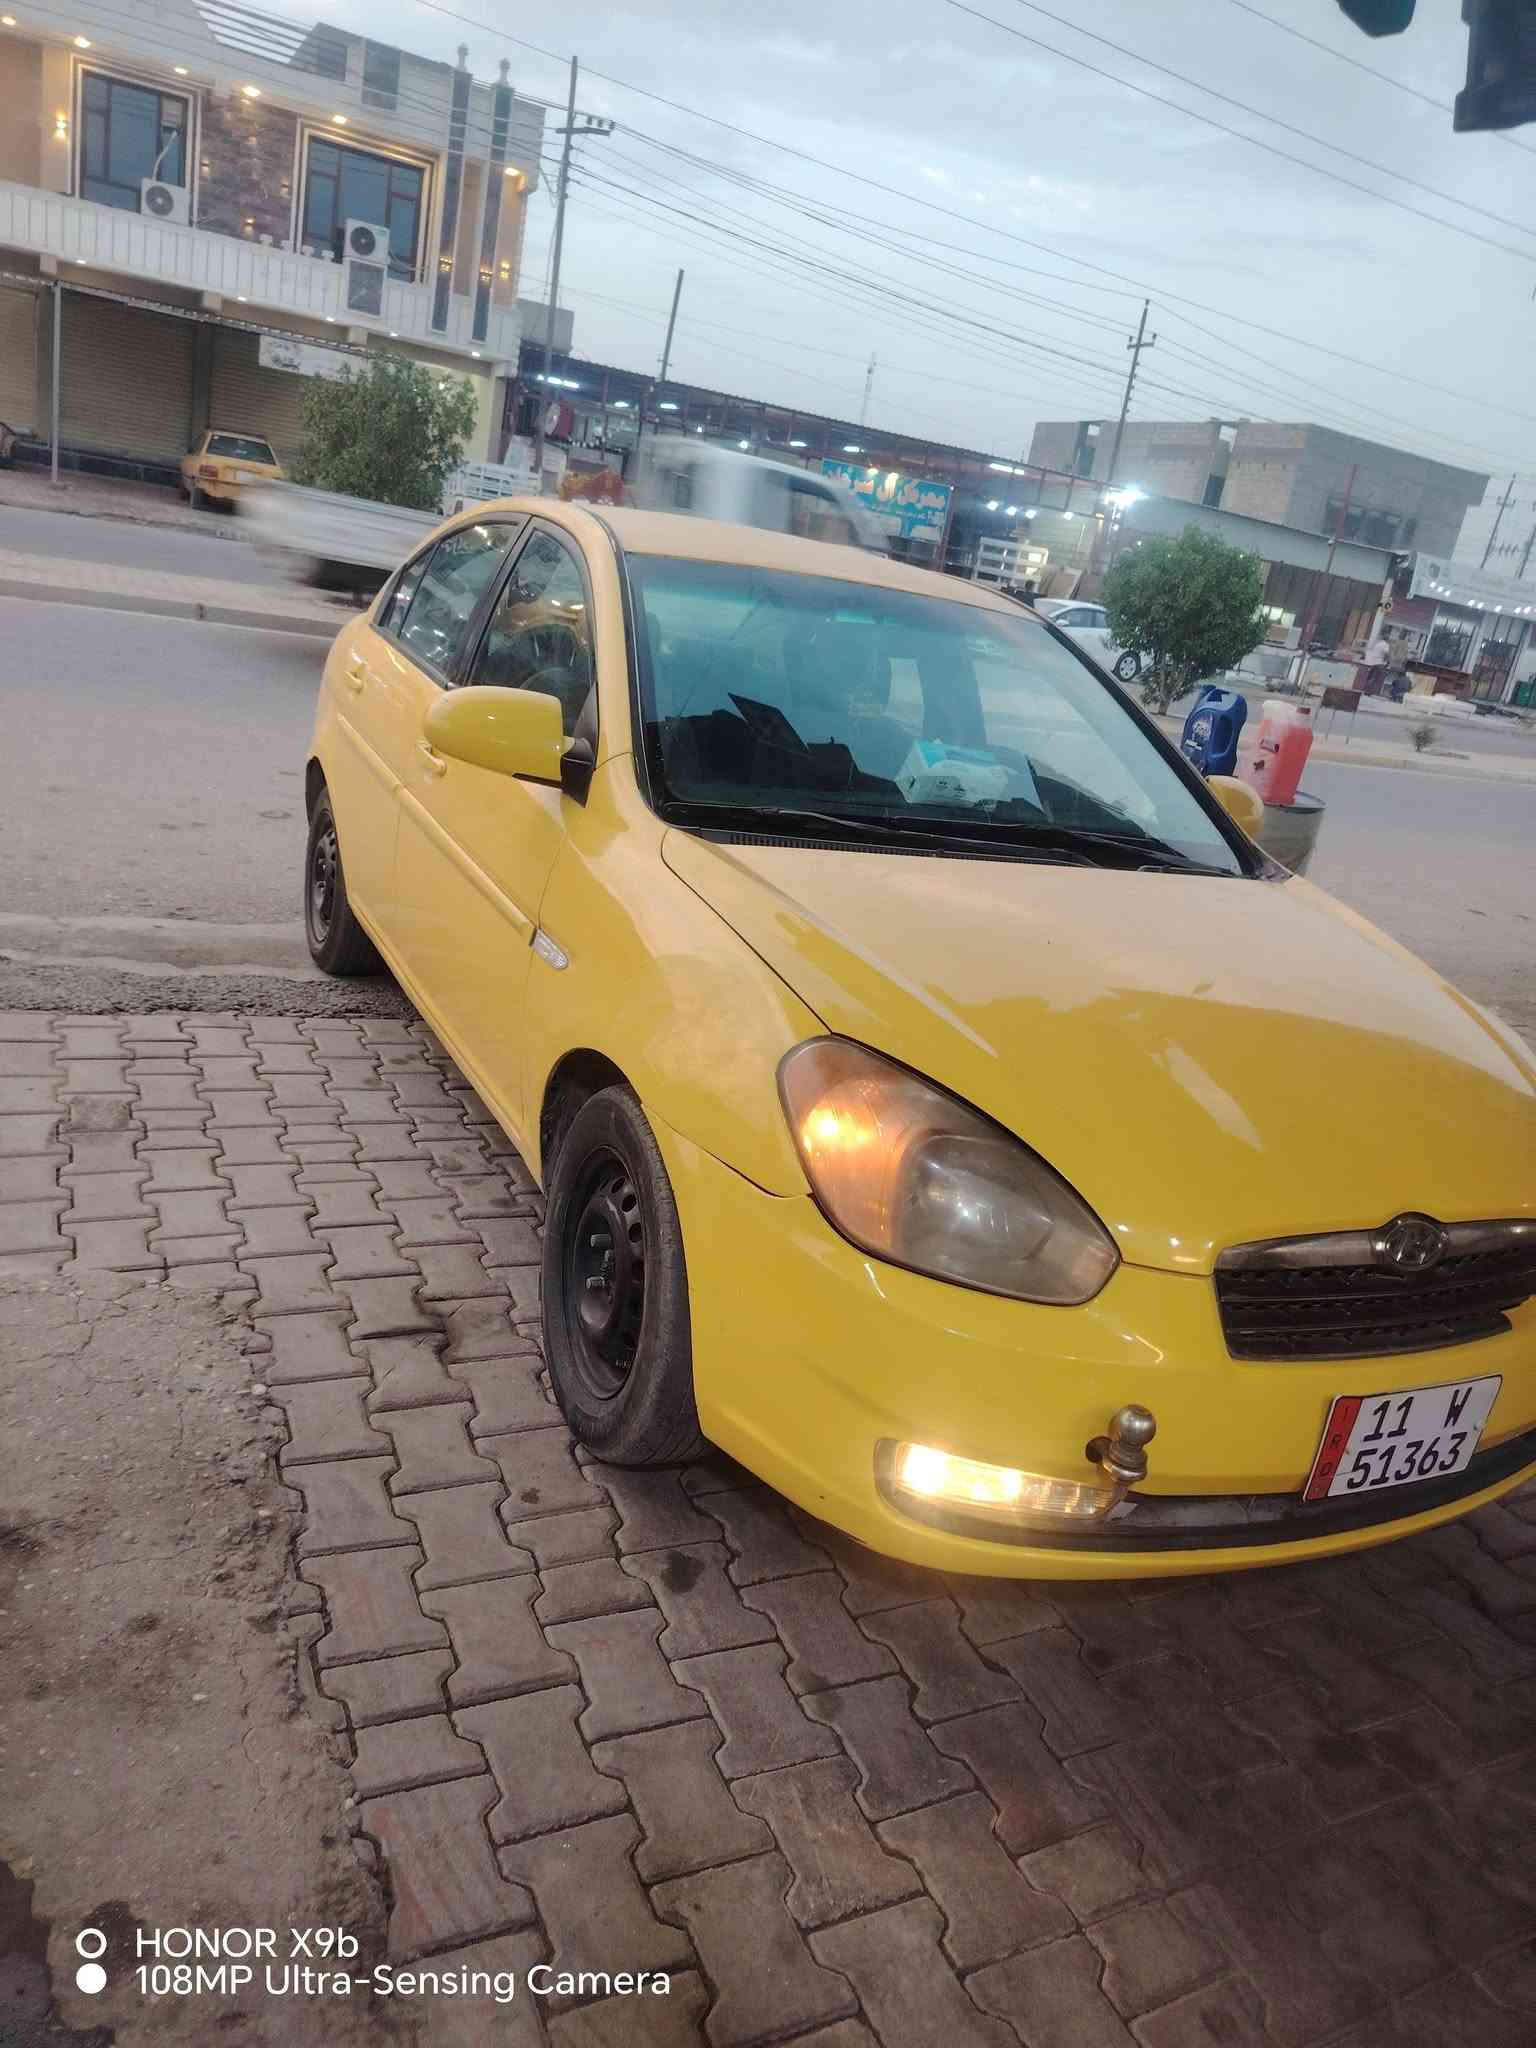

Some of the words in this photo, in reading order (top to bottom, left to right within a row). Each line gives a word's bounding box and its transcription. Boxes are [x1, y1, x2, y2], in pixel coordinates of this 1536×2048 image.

[1363, 1396, 1413, 1442] 11
[1444, 1386, 1473, 1428] W
[1347, 1431, 1468, 1489] 51363
